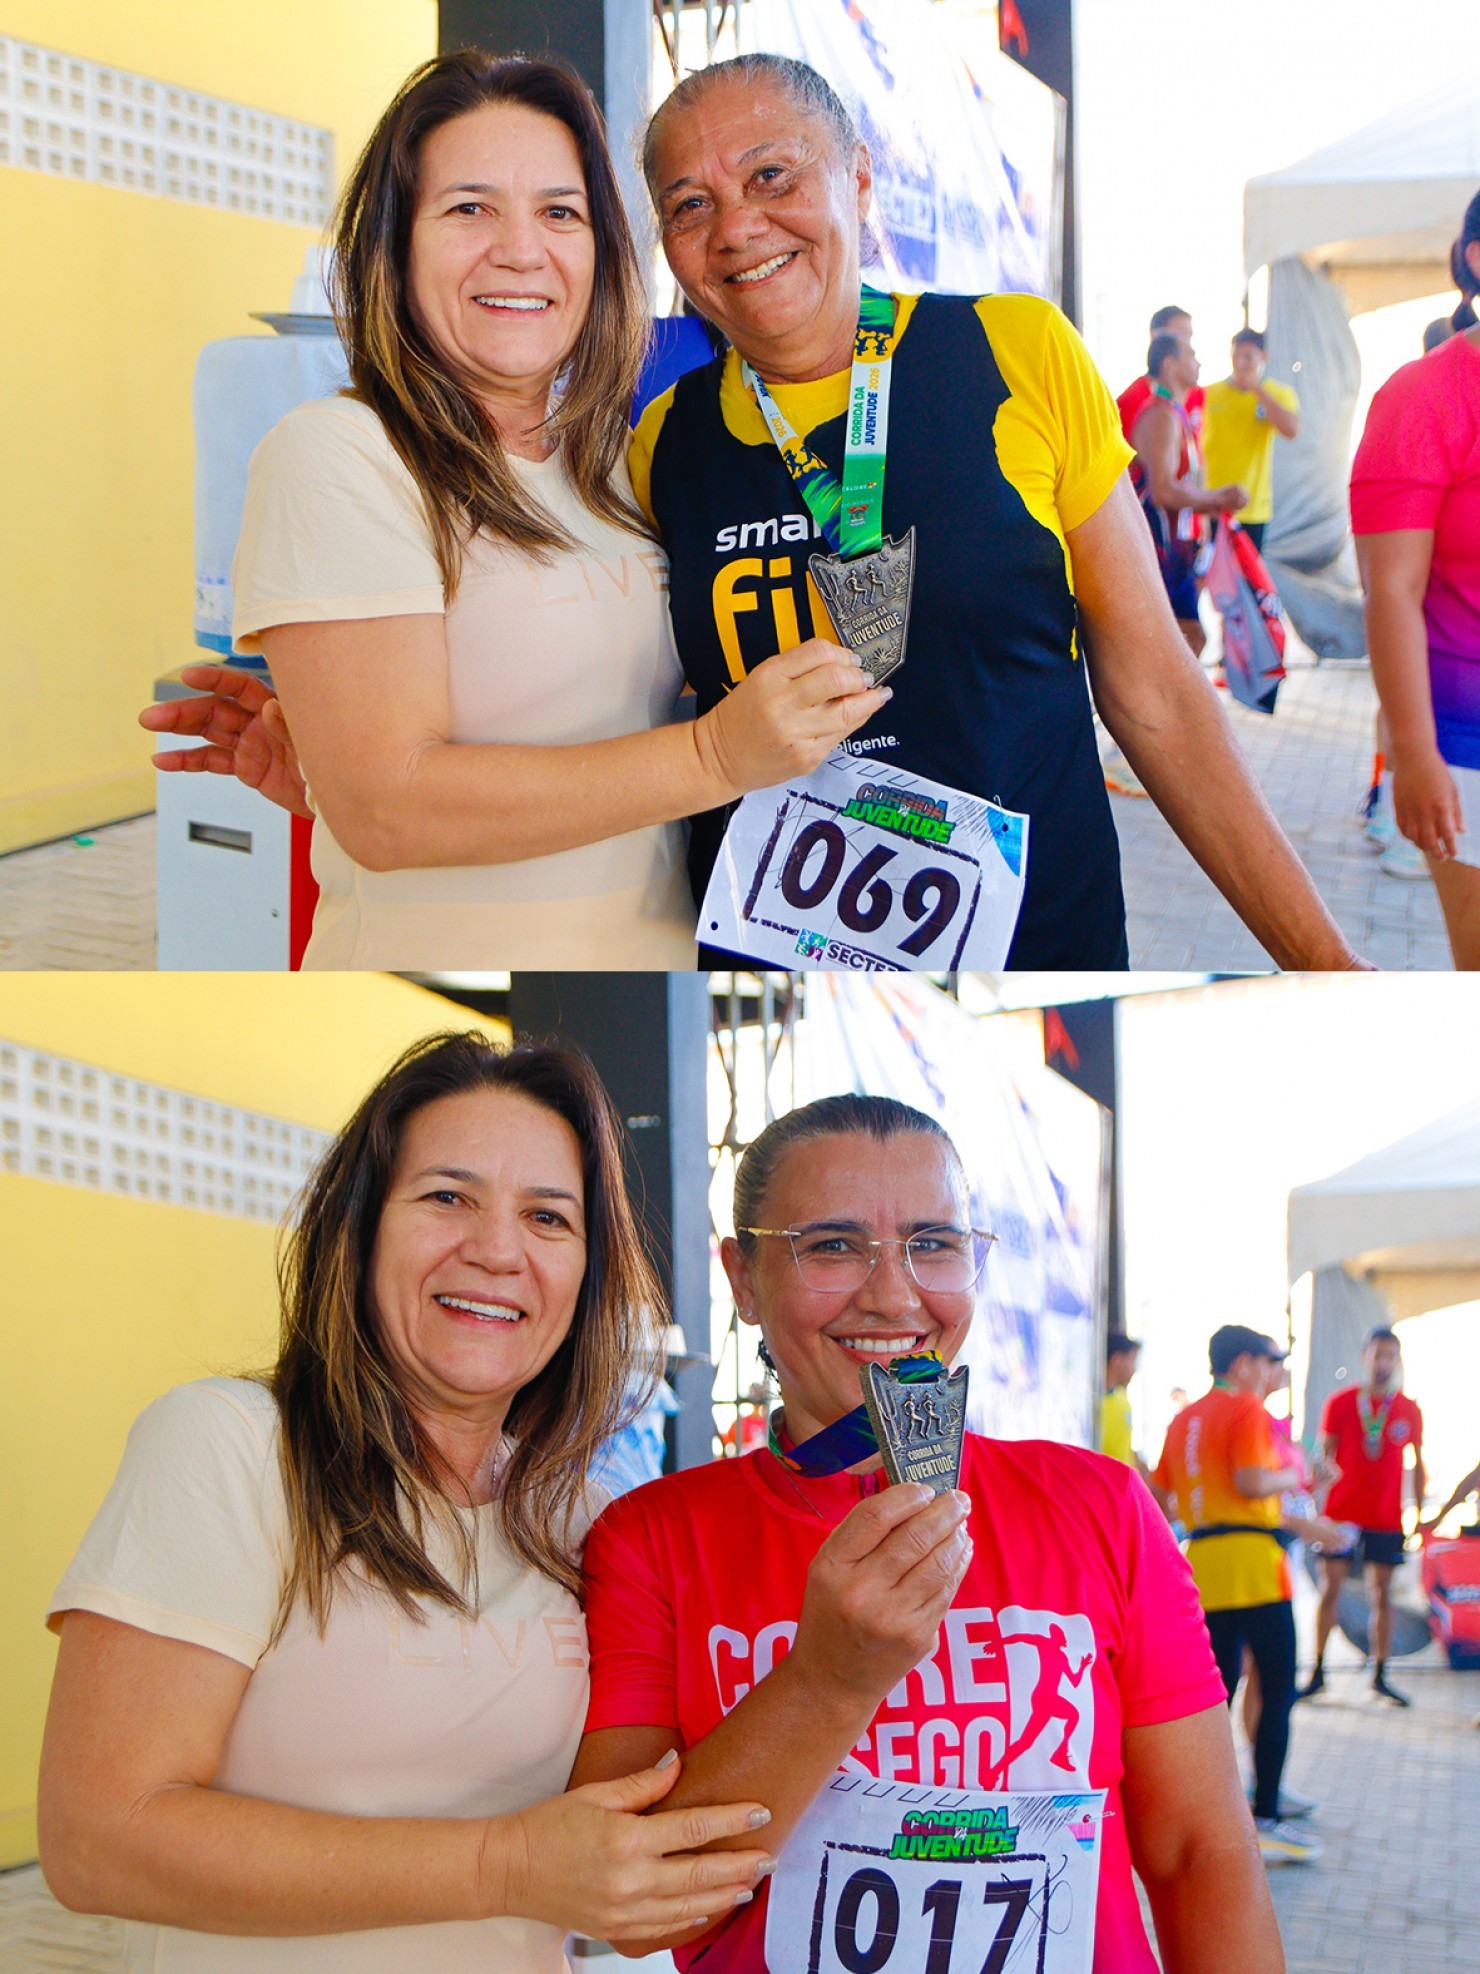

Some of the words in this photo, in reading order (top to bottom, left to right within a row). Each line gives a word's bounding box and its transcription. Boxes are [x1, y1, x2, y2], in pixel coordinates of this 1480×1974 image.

[854, 386, 865, 400] DA
[868, 368, 880, 390] 2026
[851, 402, 864, 446] CORRIDA
[865, 392, 878, 445] JUVENTUDE
[850, 612, 902, 648] JUVENTUDE
[851, 611, 878, 629] CORRIDA
[877, 606, 888, 616] DA
[856, 782, 948, 821] CORRIDA
[841, 798, 956, 844] JUVENTUDE
[781, 820, 961, 957] 069
[905, 1455, 956, 1481] JUVENTUDE
[390, 1612, 586, 1669] LIVE
[901, 1806, 1010, 1836] CORRIDA
[887, 1826, 1019, 1860] JUVENTUDE
[834, 1867, 1033, 1974] 017
